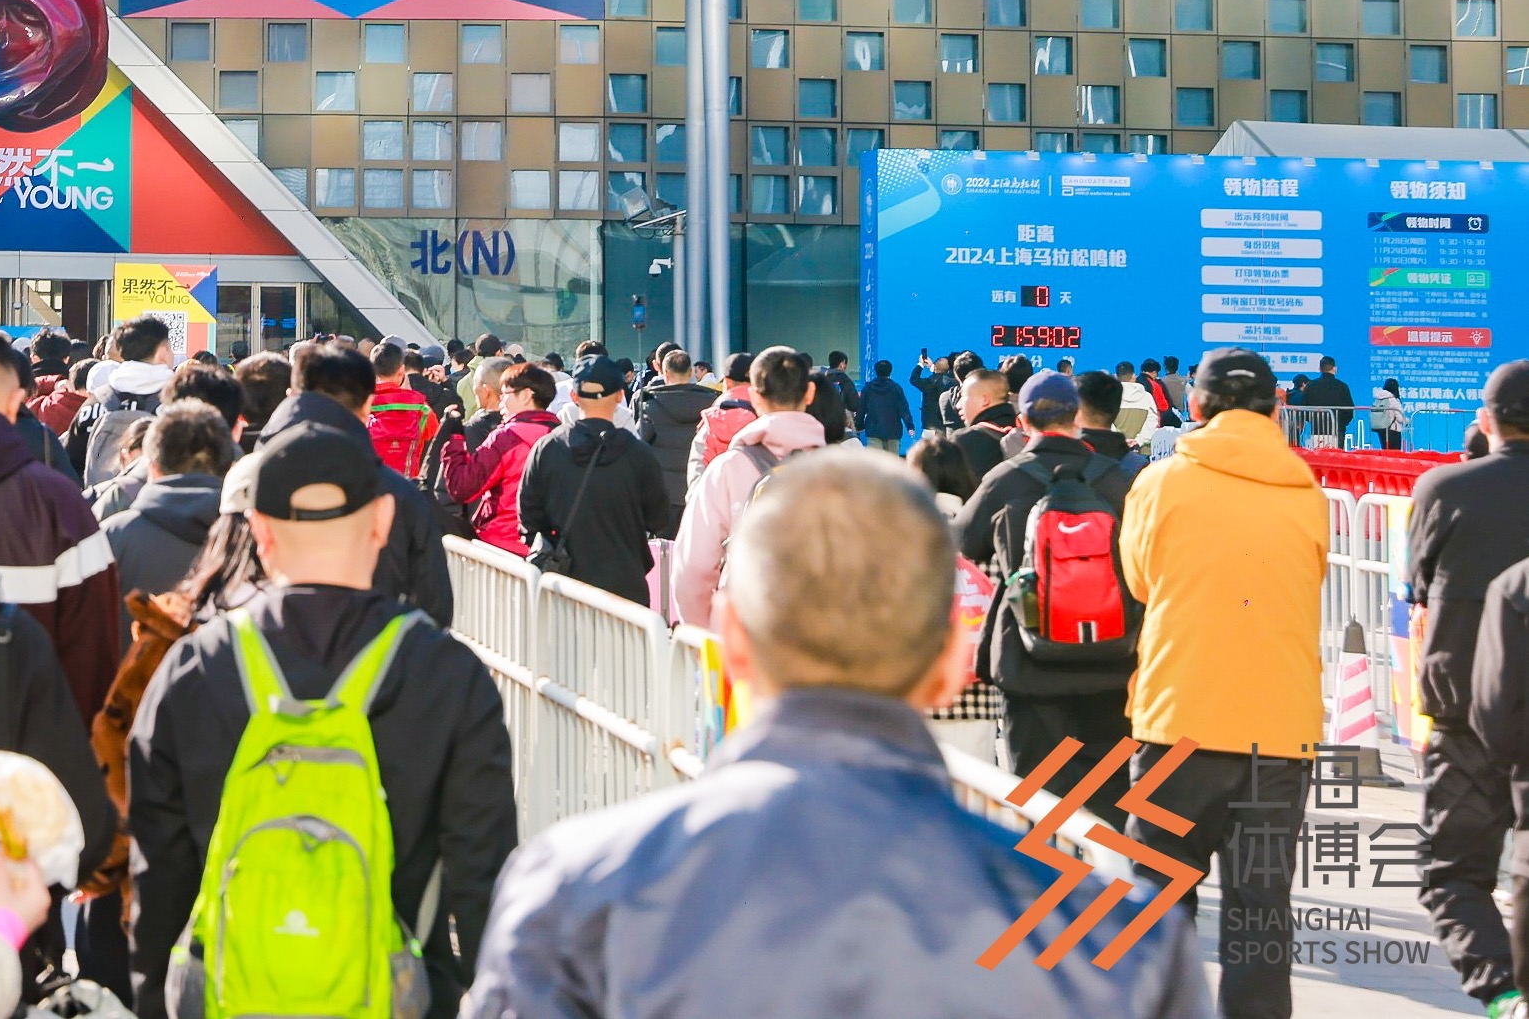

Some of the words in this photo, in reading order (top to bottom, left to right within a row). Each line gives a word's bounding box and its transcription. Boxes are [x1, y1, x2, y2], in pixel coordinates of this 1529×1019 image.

[1062, 177, 1106, 185] CANDIDATE
[1108, 178, 1129, 186] RACE
[1223, 177, 1300, 197] 领物流程
[13, 183, 114, 211] YOUNG
[1390, 180, 1467, 200] 领物须知
[1405, 216, 1452, 229] 领物时间
[1017, 224, 1055, 243] 距离
[1243, 241, 1280, 249] 身份识别
[410, 230, 516, 276] 北(N)
[945, 247, 1127, 268] 2024上海马拉松鸣枪
[1407, 272, 1452, 284] 领物凭证
[149, 293, 191, 305] YOUNG
[991, 289, 1017, 304] 还有
[1059, 291, 1072, 305] 天
[1407, 330, 1453, 343] 温馨提示
[1030, 355, 1043, 368] 分
